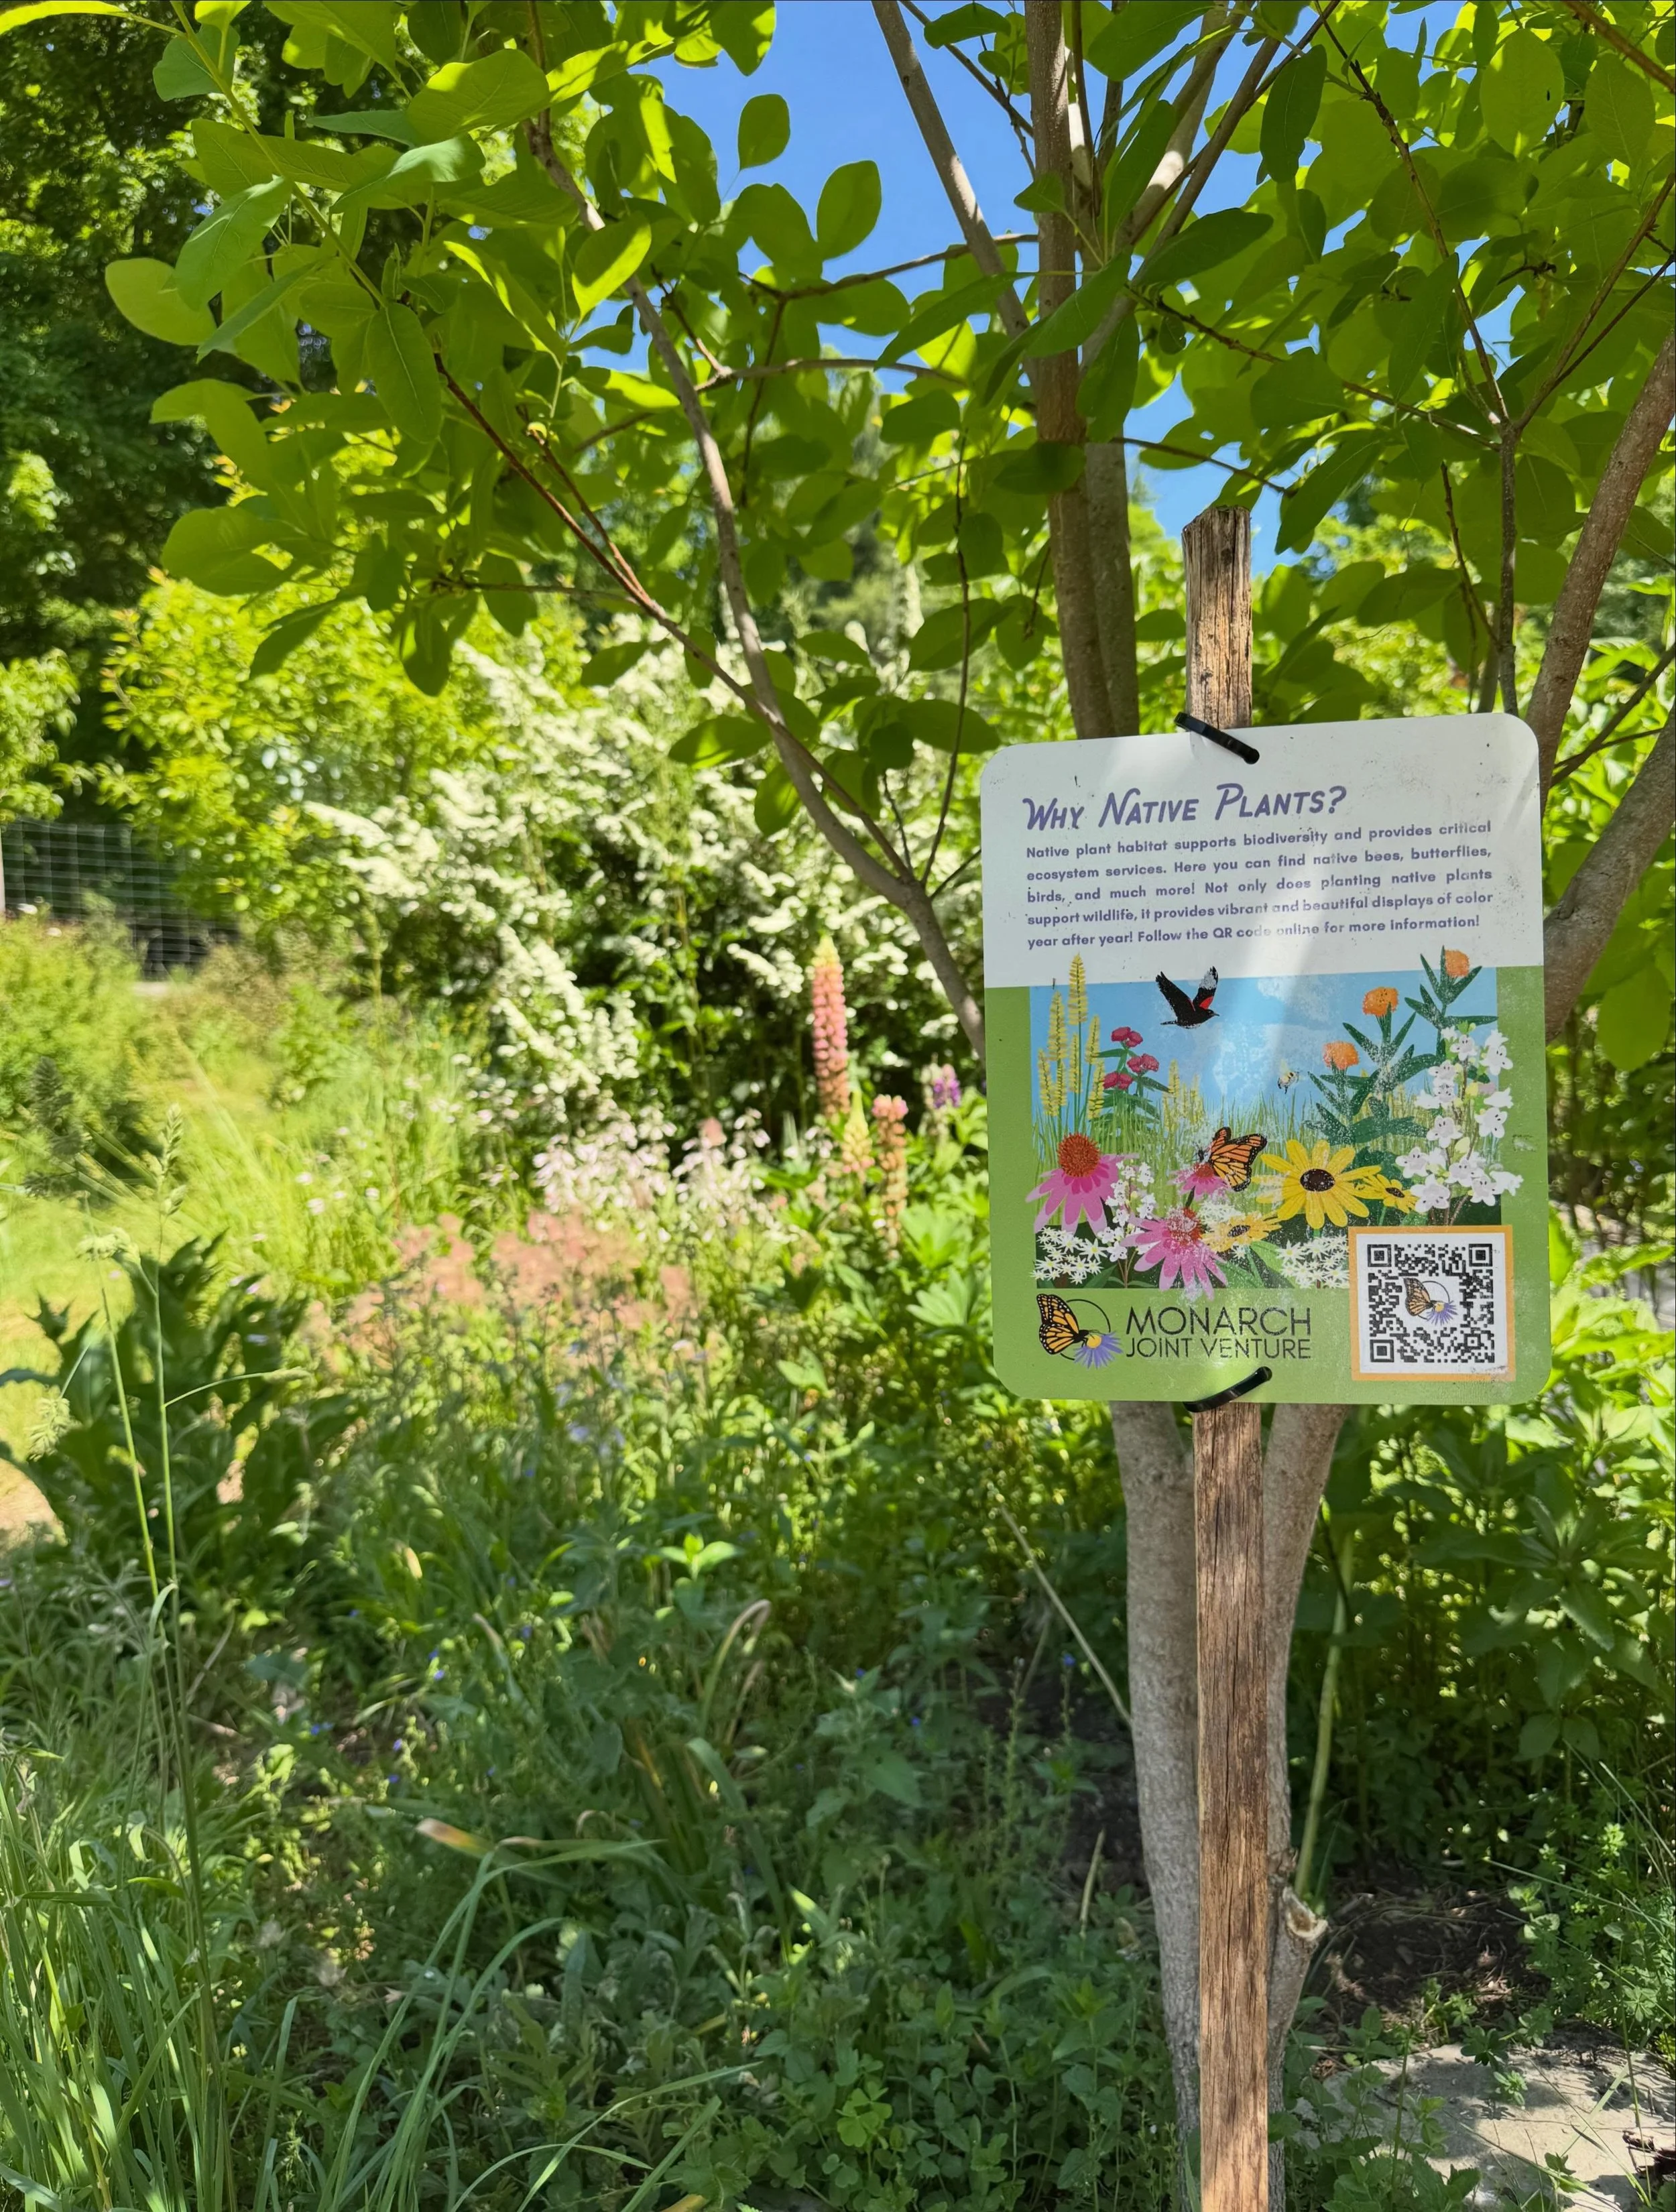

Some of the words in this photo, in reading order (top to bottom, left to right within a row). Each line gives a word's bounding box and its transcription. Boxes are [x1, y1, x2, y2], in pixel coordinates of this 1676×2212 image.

[1026, 846, 1069, 858] Native
[1076, 843, 1111, 859] plant
[1118, 841, 1168, 853] habitat
[1175, 837, 1236, 852] supports
[1244, 830, 1328, 846] biodiversity
[1334, 827, 1362, 841] and
[1369, 824, 1432, 842] provides
[1439, 820, 1492, 835] critical
[1027, 869, 1099, 881] ecosystem
[1105, 865, 1166, 877] services.
[1175, 861, 1207, 873] Here
[1213, 861, 1238, 873] you
[1245, 859, 1270, 869] can
[1278, 853, 1305, 867] find
[1313, 853, 1358, 865] native
[1365, 850, 1404, 863] bees,
[1411, 845, 1492, 860] butterflies,
[1028, 890, 1065, 903] birds,
[1075, 887, 1101, 900] and
[1110, 885, 1146, 899] much
[1156, 883, 1195, 896] more!
[1205, 882, 1228, 894] Not
[1238, 878, 1267, 894] only
[1276, 877, 1311, 890] does
[1321, 874, 1381, 890] planting
[1392, 871, 1436, 884] native
[1446, 869, 1492, 884] plants
[1028, 912, 1080, 927] support
[1083, 909, 1138, 922] wildlife,
[1141, 908, 1151, 920] it
[1154, 905, 1215, 922] provides
[1217, 902, 1268, 916] vibrant
[1272, 900, 1299, 912] and
[1303, 896, 1368, 911] beautiful
[1372, 894, 1433, 910] displays
[1437, 893, 1452, 905] of
[1455, 891, 1494, 904] color
[1028, 938, 1059, 950] year
[1062, 933, 1095, 947] after
[1099, 931, 1134, 946] year!
[1138, 930, 1182, 942] Follow
[1186, 928, 1208, 940] the
[1213, 927, 1232, 939] QR
[1236, 924, 1271, 938] code
[1276, 922, 1319, 936] online
[1324, 921, 1345, 934] for
[1348, 922, 1386, 932] more
[1390, 915, 1480, 930] information!
[1126, 1306, 1311, 1336] MONARCH
[1126, 1338, 1192, 1357] JOINT
[1201, 1338, 1311, 1359] VENTURE
